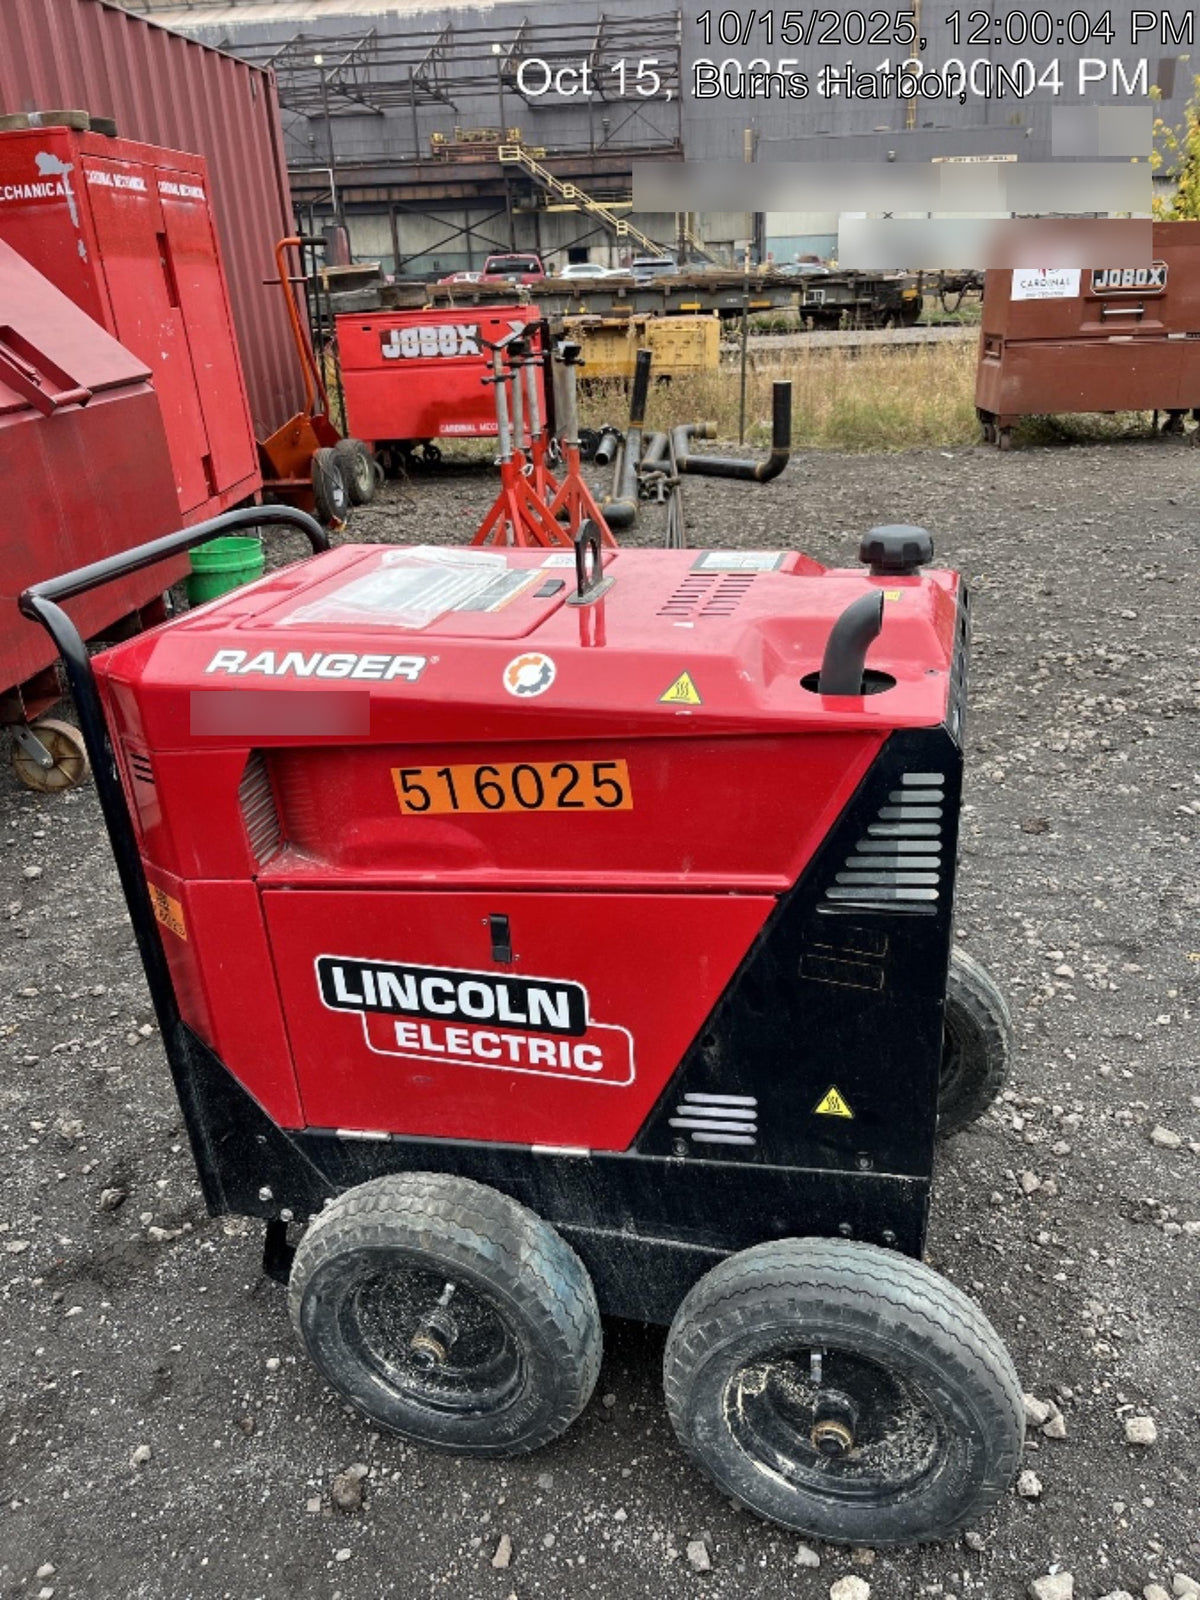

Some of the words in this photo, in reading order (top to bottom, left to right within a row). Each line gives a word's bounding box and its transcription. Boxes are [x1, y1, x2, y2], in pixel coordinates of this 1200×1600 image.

[1095, 269, 1162, 287] JOBOX
[382, 324, 483, 358] JOBOX
[203, 648, 428, 683] RANGER
[400, 762, 623, 811] 516025
[331, 966, 571, 1028] LINCOLN
[394, 1020, 604, 1072] ELECTRIC
